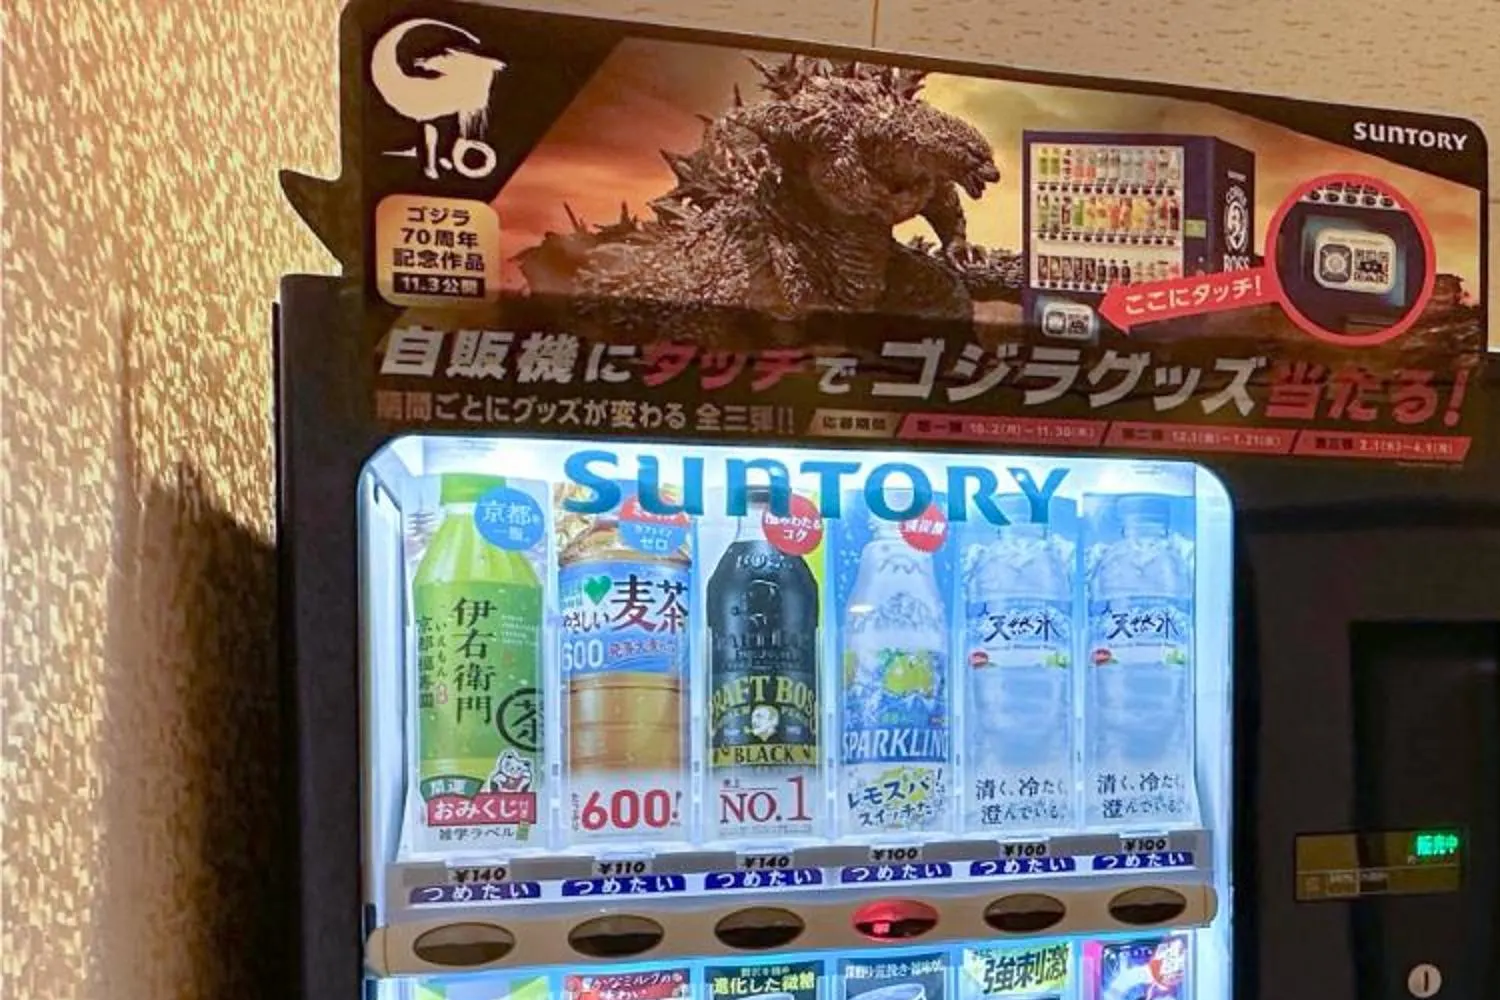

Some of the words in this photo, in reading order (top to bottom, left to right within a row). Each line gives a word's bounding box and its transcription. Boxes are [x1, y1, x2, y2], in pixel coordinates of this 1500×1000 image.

[1353, 120, 1468, 152] SUNTORY
[405, 206, 471, 226] ゴジラ
[400, 227, 479, 250] 70周年
[392, 248, 485, 273] 記念作品
[401, 276, 479, 295] 11.3公開
[562, 450, 1071, 526] SUNTORY
[609, 574, 688, 635] 麦茶
[984, 612, 1062, 643] 天然水
[1107, 611, 1180, 641] 天然水
[452, 597, 498, 726] 伊右衛門
[734, 745, 794, 763] BLACK
[872, 848, 919, 861] ¥100
[1004, 843, 1046, 856] ¥100
[1124, 839, 1166, 852] ¥100
[599, 862, 645, 875] ¥110
[743, 856, 790, 869] ¥140
[979, 858, 1067, 876] つめたい
[1102, 852, 1185, 869] つめたい
[455, 868, 506, 883] ¥140
[716, 868, 812, 889] つめたい
[851, 862, 943, 881] つめたい
[421, 882, 531, 901] つめたい
[573, 875, 675, 896] つめたい
[983, 943, 1069, 994] 強刺激
